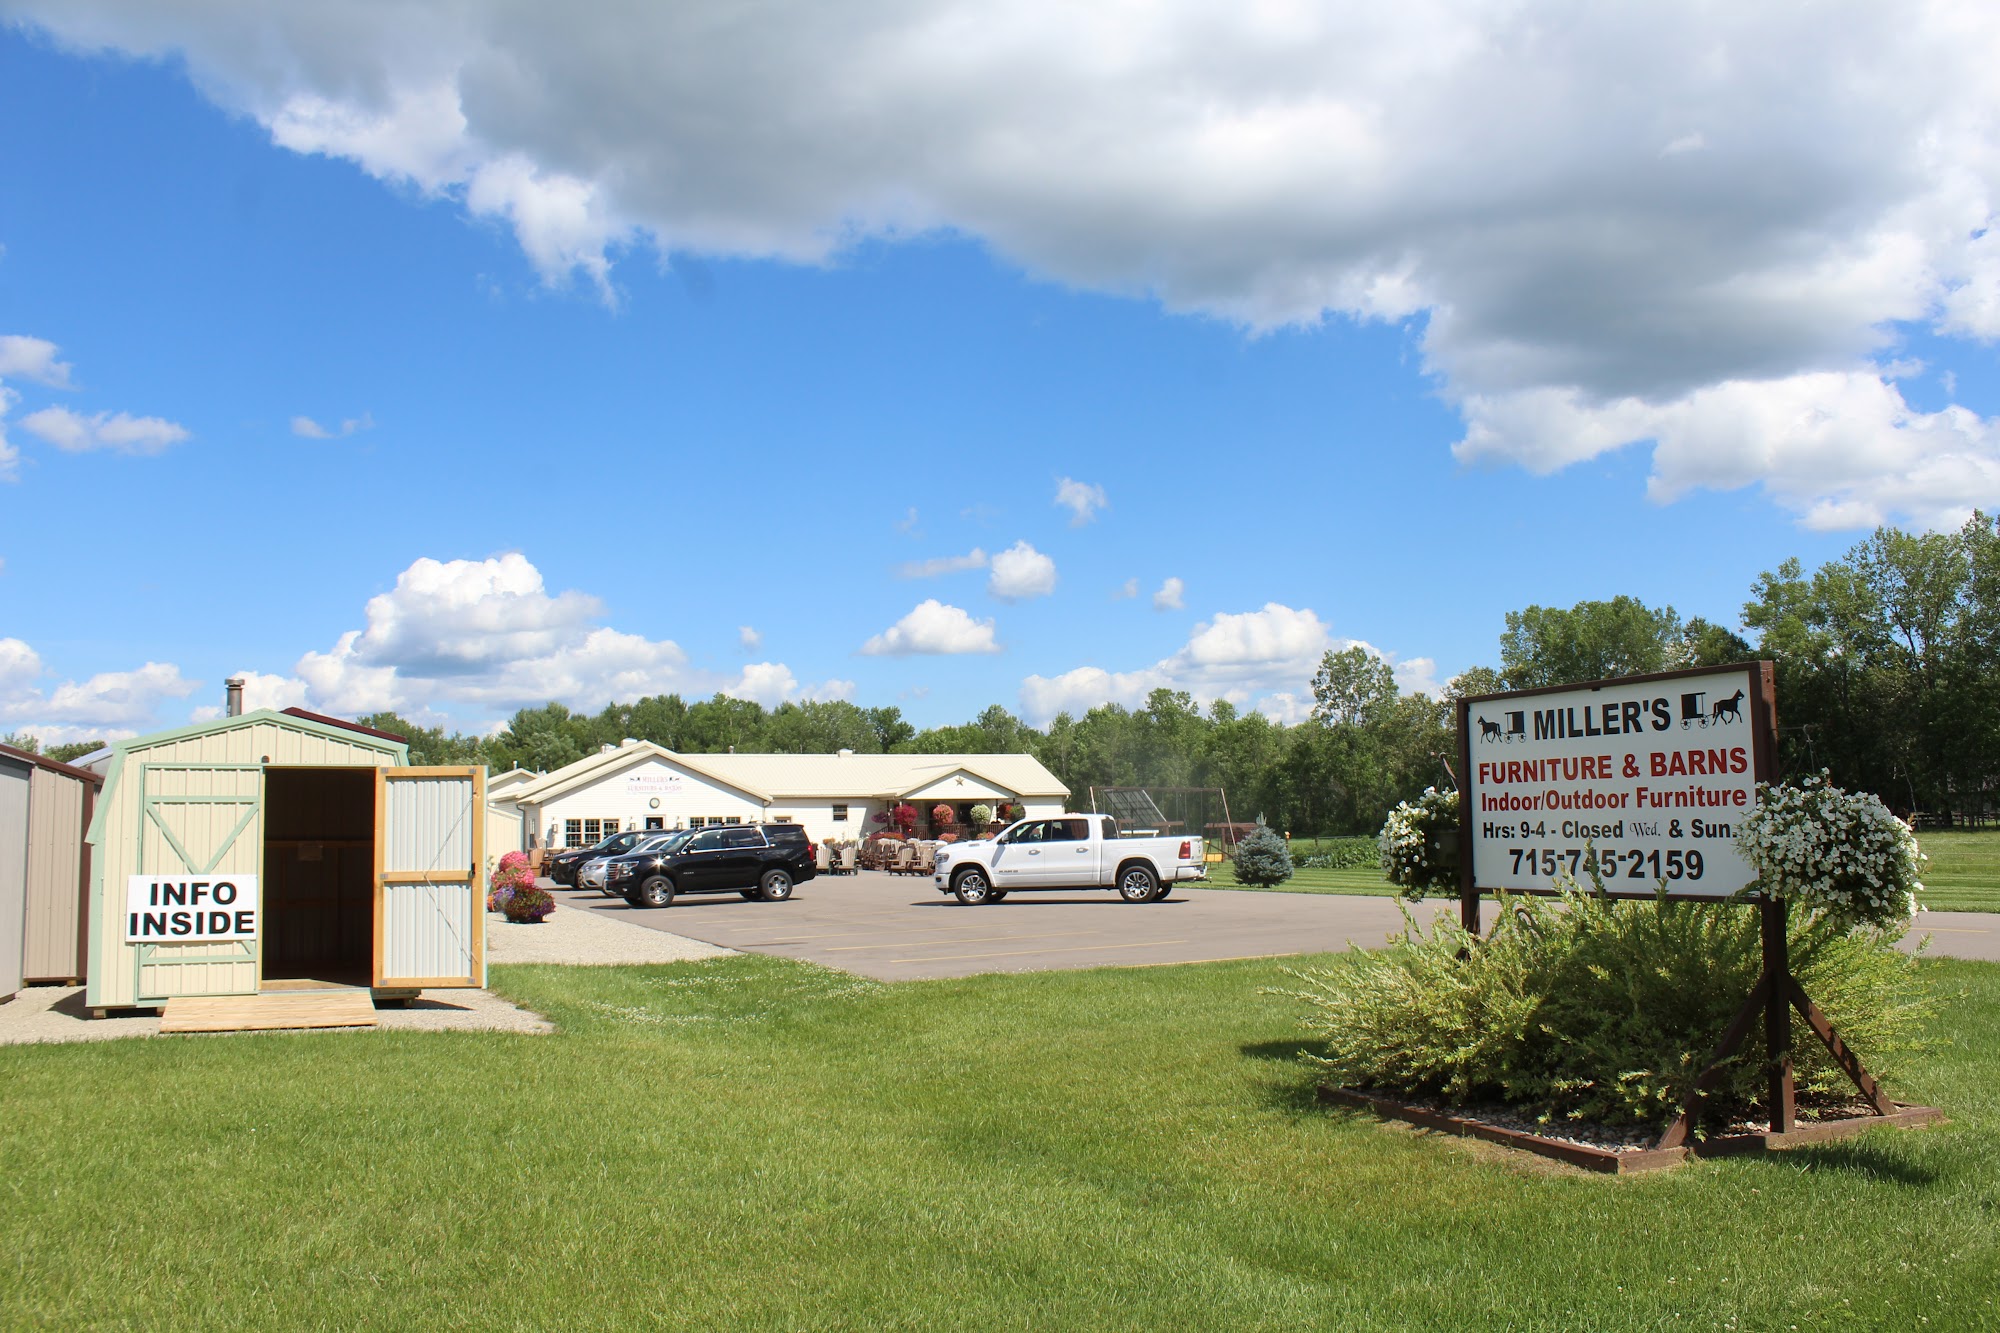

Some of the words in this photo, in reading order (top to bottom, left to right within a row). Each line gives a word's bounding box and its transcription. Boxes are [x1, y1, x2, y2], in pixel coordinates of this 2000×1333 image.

[1534, 698, 1671, 740] MILLER'S
[1479, 755, 1613, 785] FURNITURE
[1622, 753, 1640, 778] &
[1650, 747, 1748, 777] BARNS
[1481, 788, 1630, 811] Indoor/Outdoor
[1636, 785, 1747, 808] Furniture
[1483, 821, 1515, 839] Hrs:
[1520, 821, 1546, 838] 9-4
[1562, 820, 1623, 838] Closed
[1629, 822, 1661, 837] Wed.
[1668, 819, 1683, 838] &
[1691, 819, 1737, 838] Sun.
[150, 882, 237, 906] INFO
[129, 911, 255, 936] INSIDE
